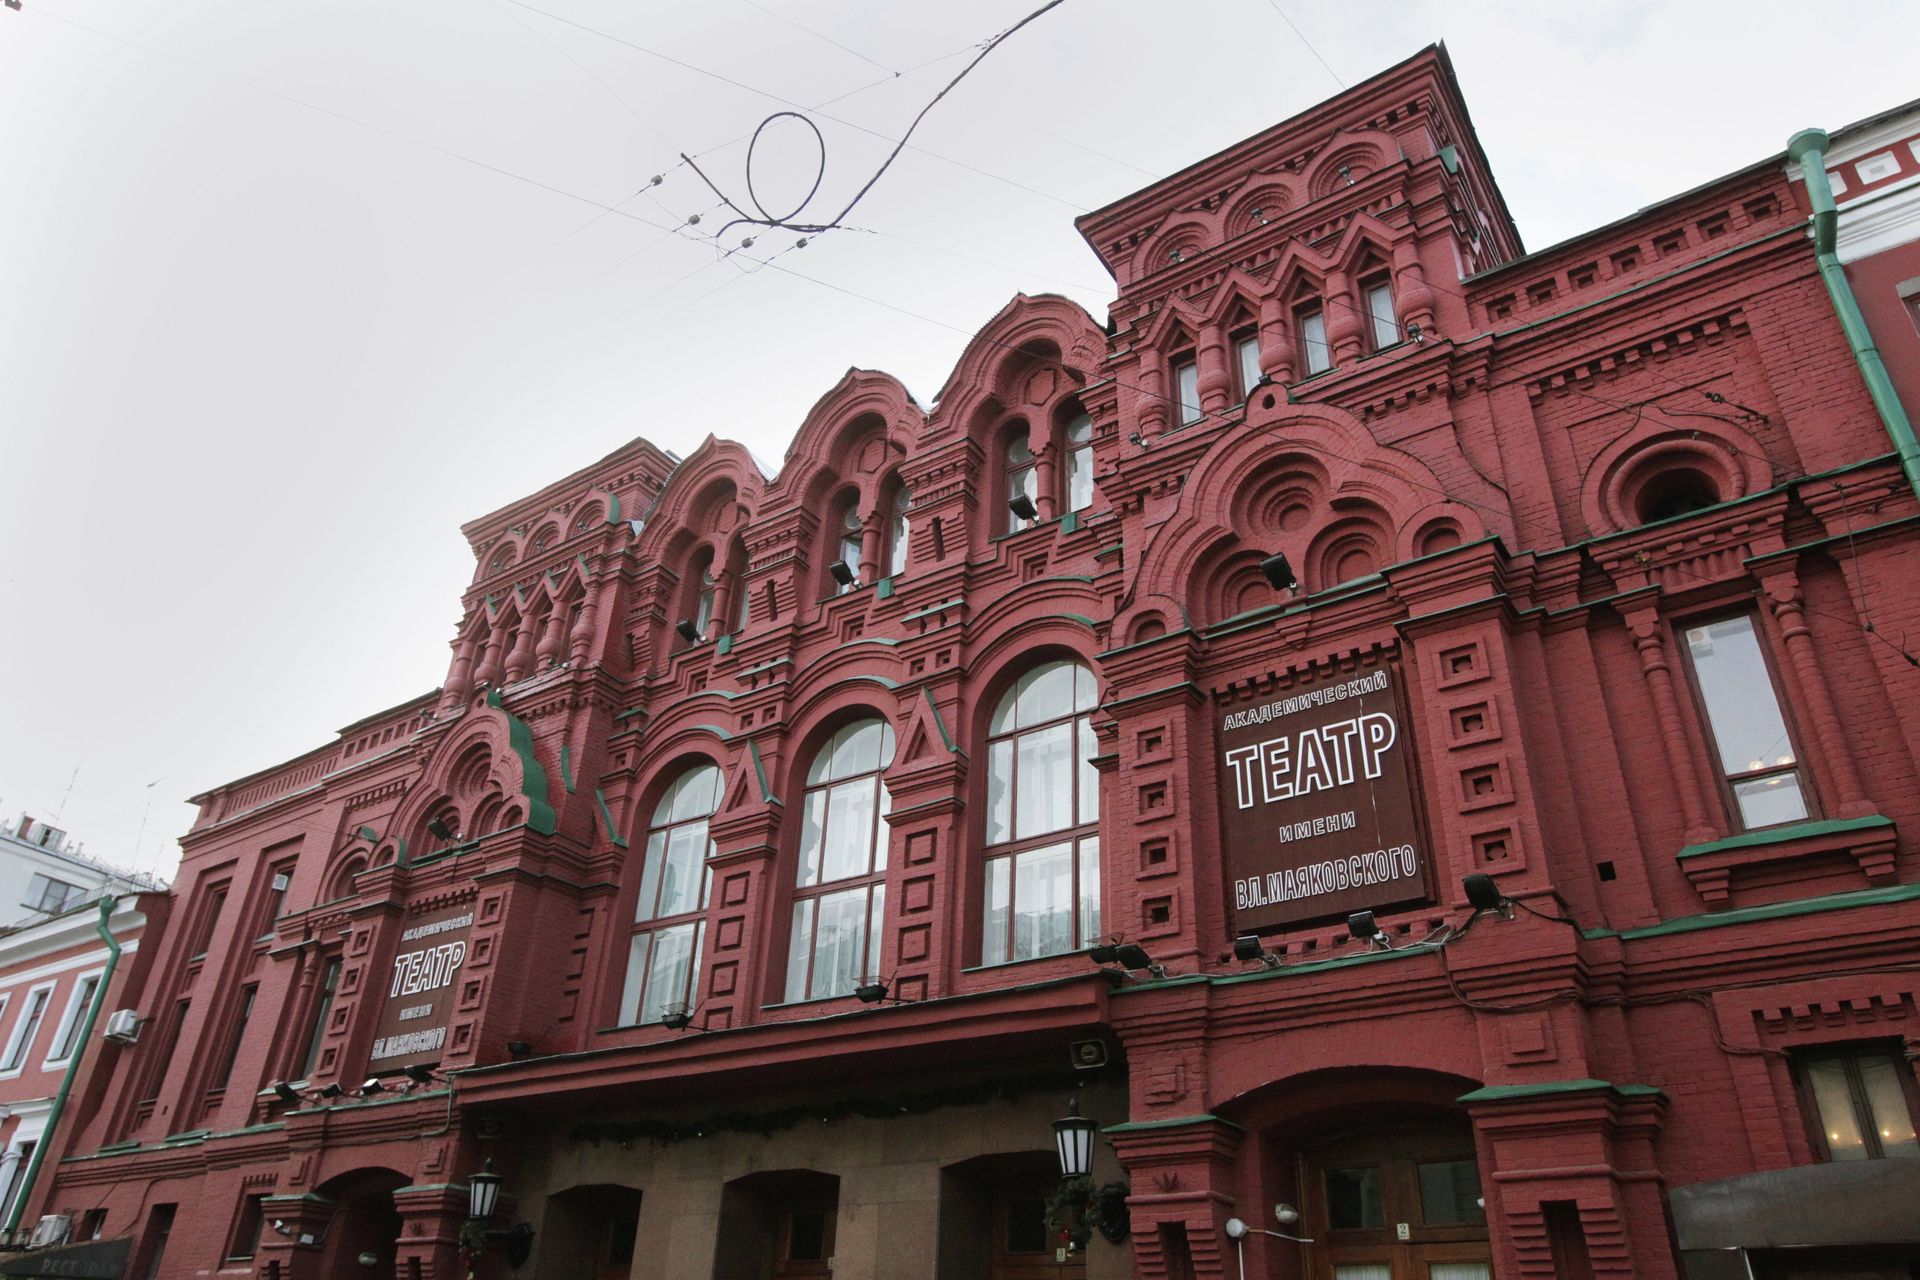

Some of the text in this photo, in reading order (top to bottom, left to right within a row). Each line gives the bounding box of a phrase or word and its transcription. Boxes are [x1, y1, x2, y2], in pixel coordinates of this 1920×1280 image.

[1224, 670, 1388, 731] АКАДЕМИЧЕСКИЙ
[1226, 712, 1396, 810] ТЕАТР
[1279, 811, 1356, 843] ИМЕНИ
[1235, 845, 1417, 910] ВЛ.МАЯКОВСКОГО
[390, 941, 468, 998] ТЕАТР
[1399, 1224, 1407, 1235] 2
